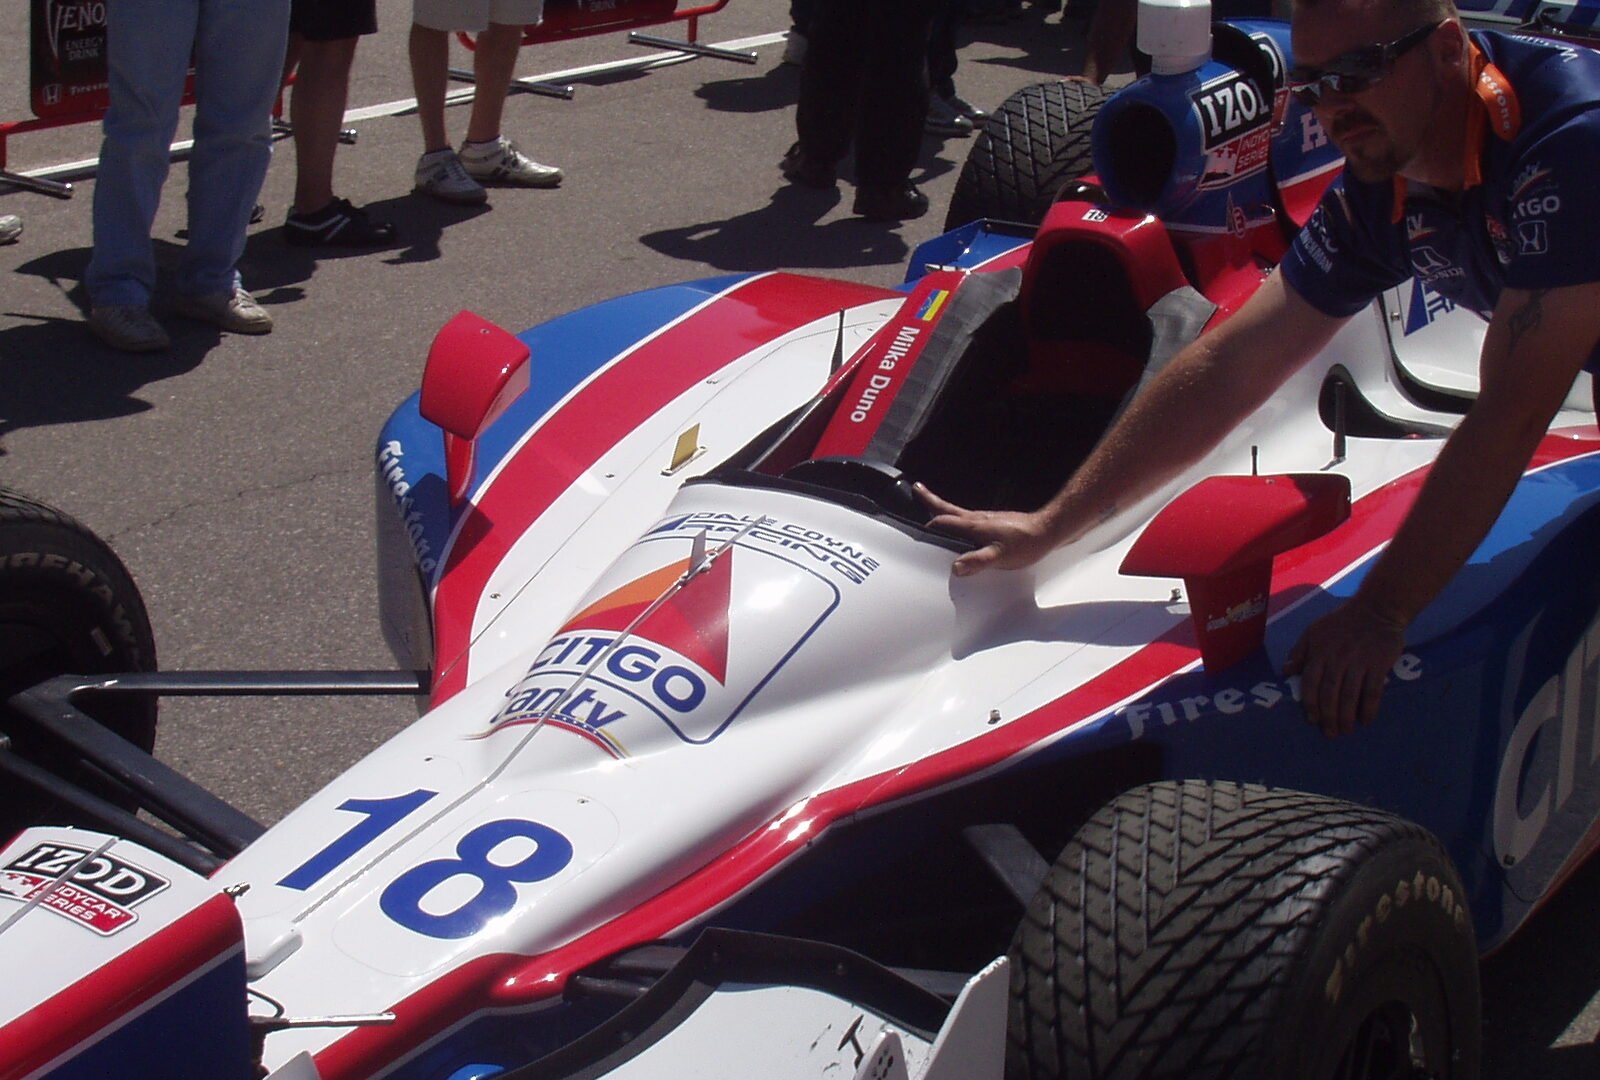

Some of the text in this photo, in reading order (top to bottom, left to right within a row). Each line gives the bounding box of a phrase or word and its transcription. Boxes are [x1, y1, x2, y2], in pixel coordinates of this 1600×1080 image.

[46, 0, 108, 58] VENO
[851, 326, 920, 423] Milka Duno
[679, 523, 864, 585] RACING
[691, 512, 880, 572] DALE COYNE
[529, 636, 706, 714] CITGO
[1126, 653, 1423, 740] Fireste
[16, 847, 147, 895] IZOD
[40, 881, 121, 920] DYCAR
